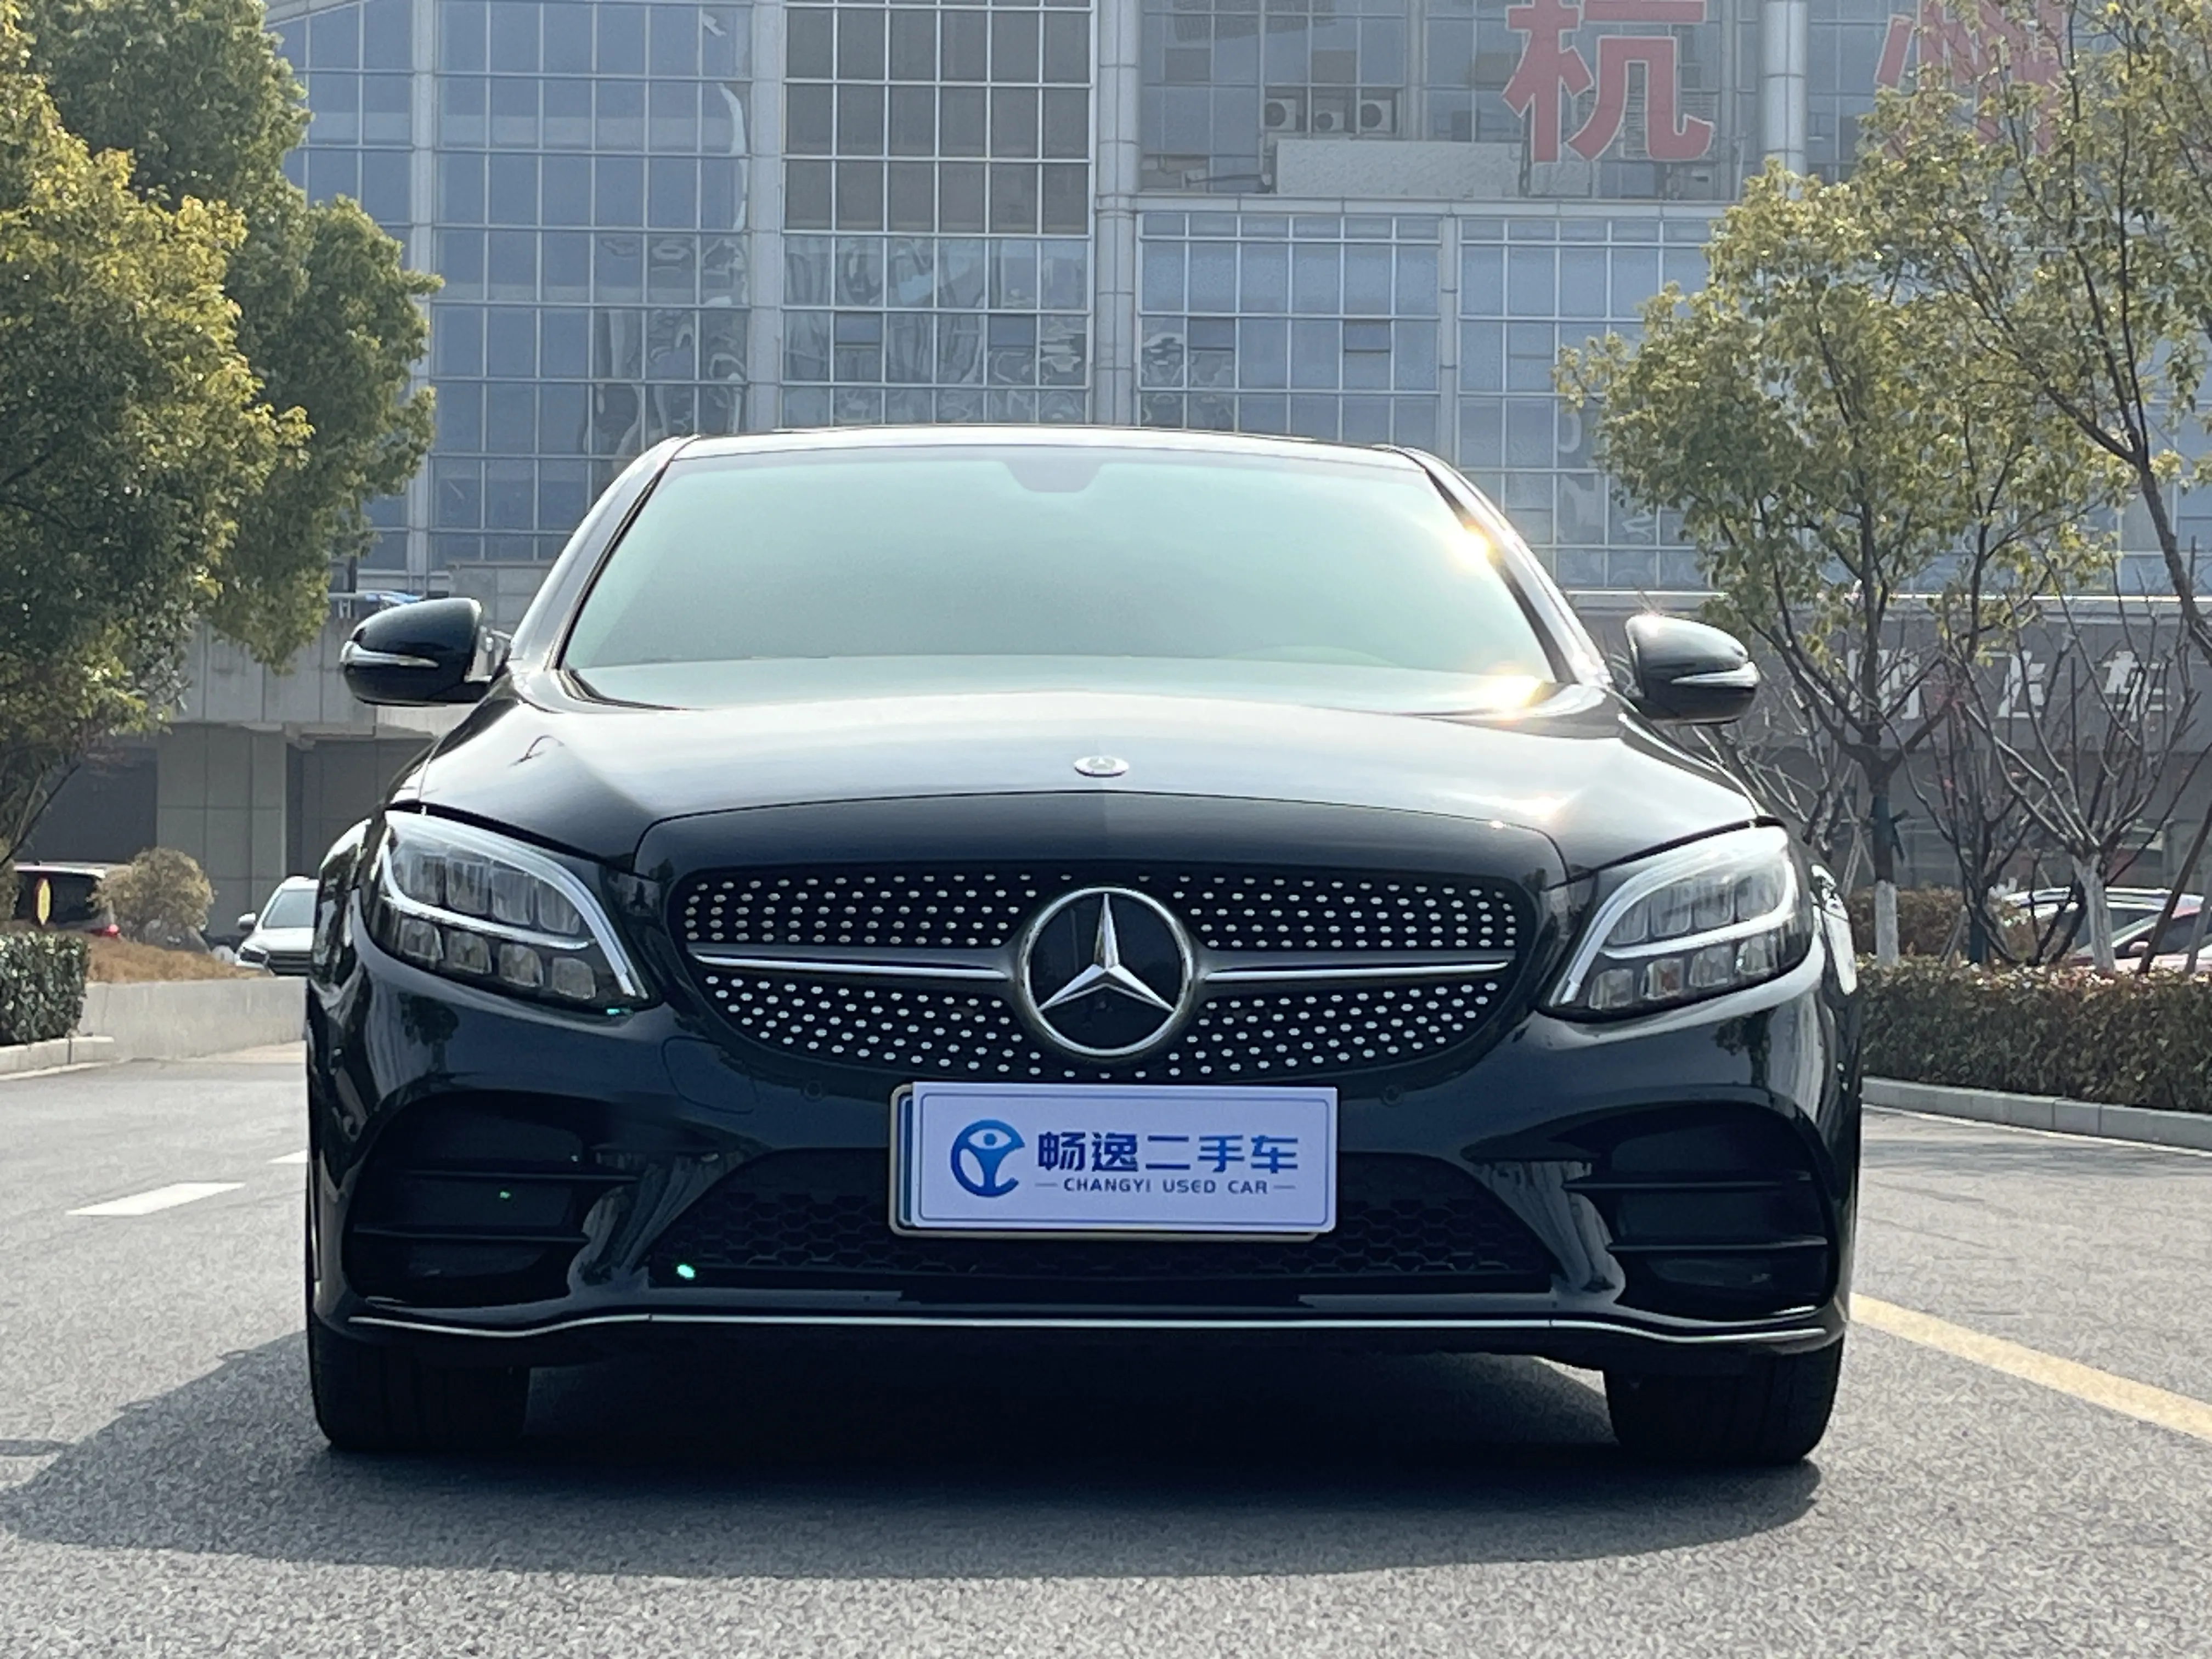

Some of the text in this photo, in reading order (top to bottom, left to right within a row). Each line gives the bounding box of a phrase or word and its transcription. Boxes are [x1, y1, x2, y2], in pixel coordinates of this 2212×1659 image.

[1037, 1131, 1299, 1174] 畅逸二手车
[1063, 1177, 1268, 1195] CHANGYI USED CAR
